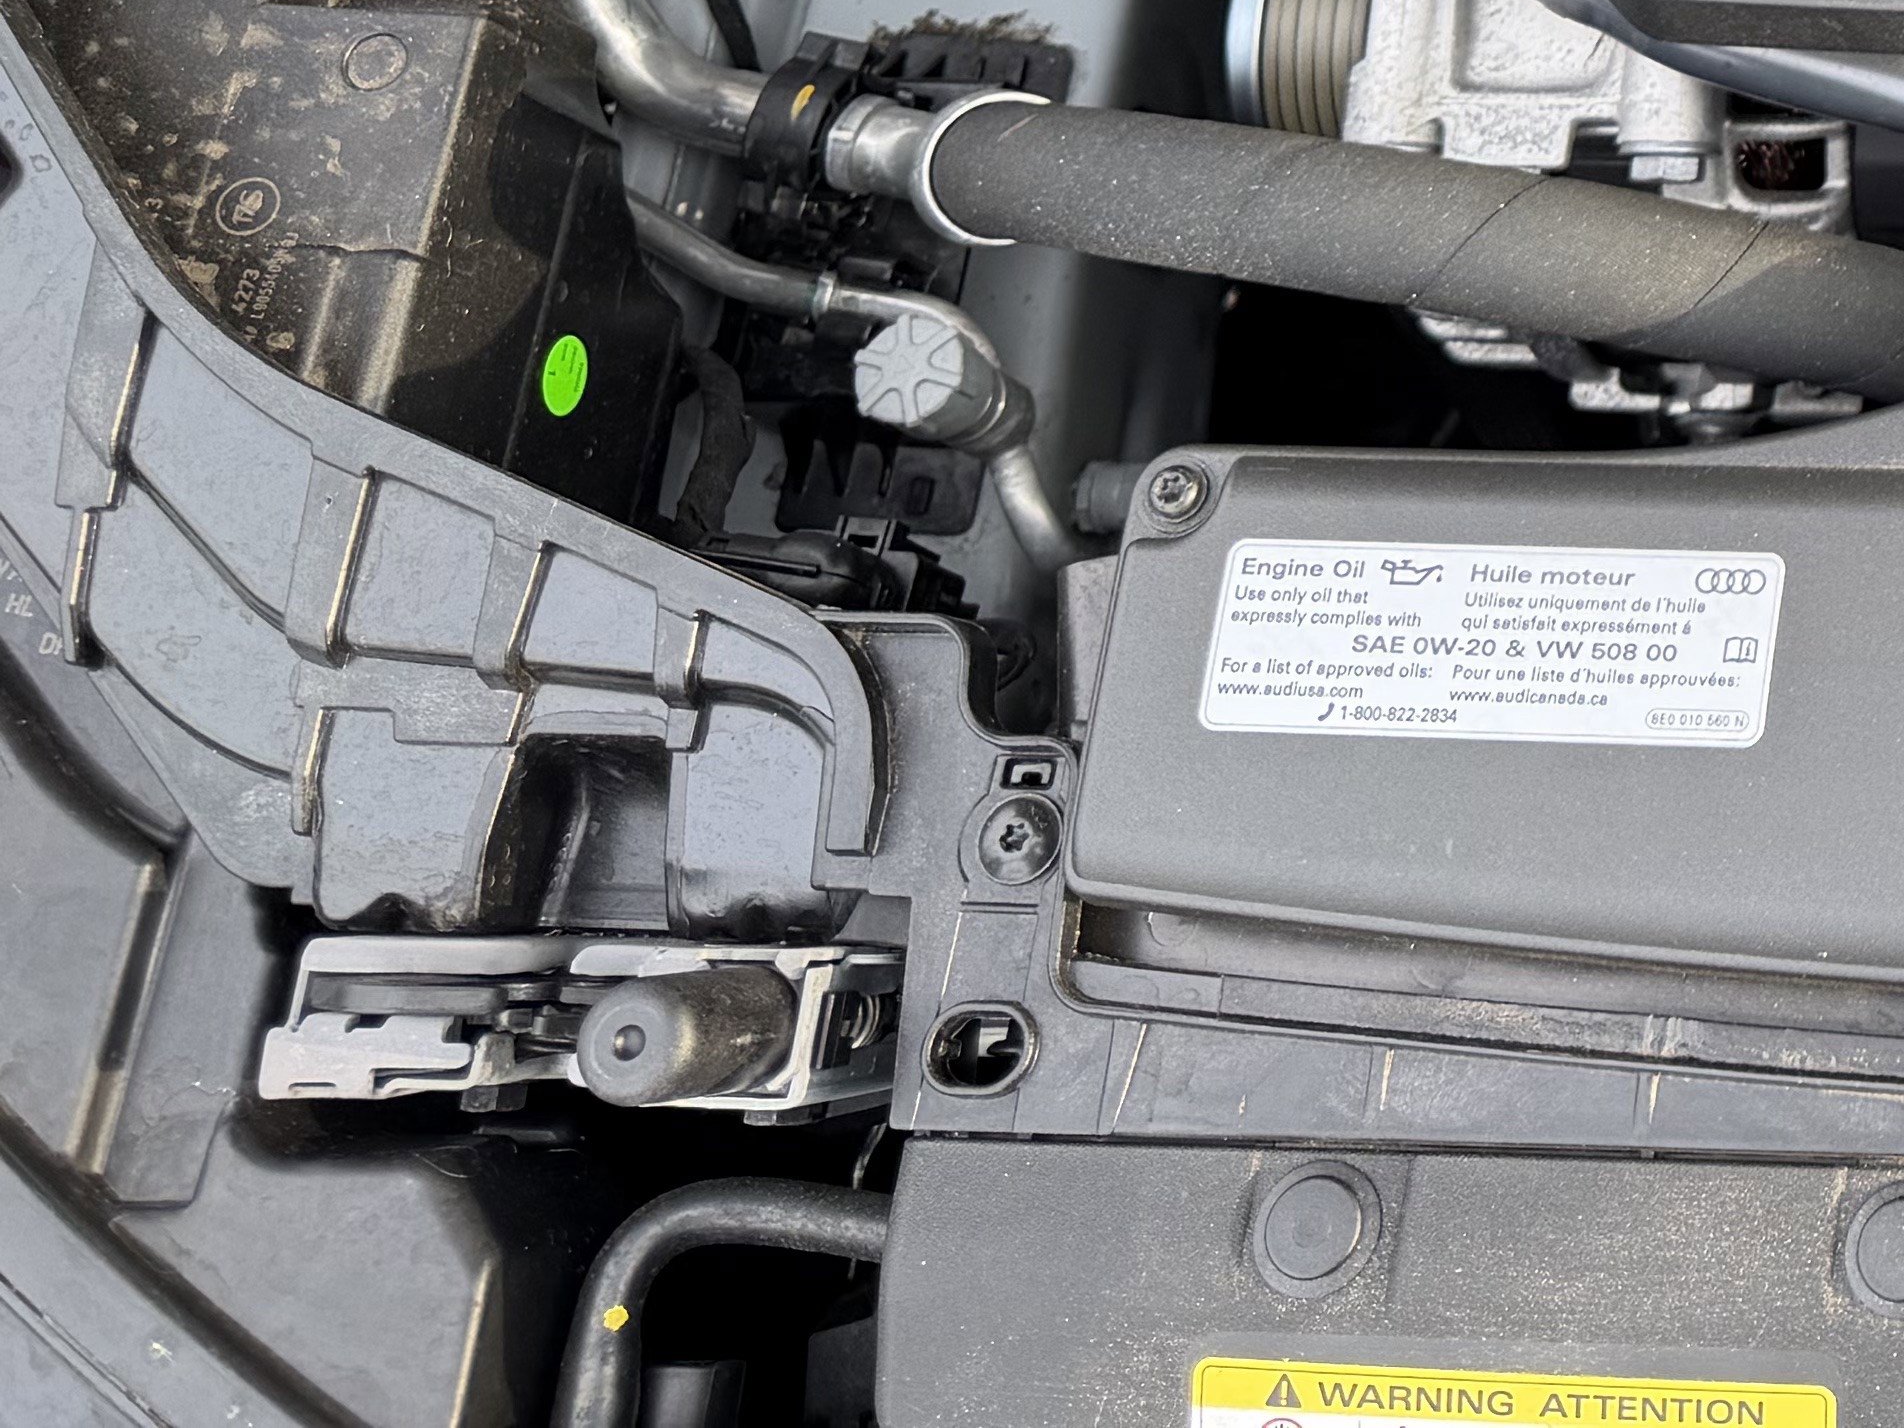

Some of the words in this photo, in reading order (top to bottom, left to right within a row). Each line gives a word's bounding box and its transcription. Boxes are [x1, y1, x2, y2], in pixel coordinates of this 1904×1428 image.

[1241, 557, 1323, 580] Engine
[1333, 560, 1365, 578] Oil
[1470, 564, 1532, 584] Huile
[1541, 569, 1636, 587] moteur
[1235, 585, 1266, 601] Use
[1271, 587, 1307, 605] only
[1311, 588, 1332, 603] oil
[1336, 588, 1368, 604] that
[1465, 592, 1523, 608] Utilisez
[1529, 593, 1626, 617] uniquement
[1631, 596, 1651, 613] de
[1656, 597, 1706, 614] l'huile
[1231, 609, 1306, 627] expressly
[1310, 611, 1382, 628] complies
[1387, 613, 1421, 628] with
[1461, 614, 1488, 632] qui
[1492, 615, 1557, 632] satisfait
[1561, 618, 1677, 635] expressément
[1351, 634, 1405, 654] SAE
[1413, 636, 1497, 657] 0W-20
[1505, 639, 1526, 658] &
[1537, 641, 1584, 659] VW
[1591, 642, 1638, 661] 508
[1646, 643, 1678, 662] 00
[1220, 657, 1248, 673] For
[1252, 661, 1262, 673] a
[1266, 659, 1291, 675] list
[1295, 659, 1314, 675] of
[1316, 661, 1394, 682] approved
[1400, 662, 1433, 679] oils:
[1452, 664, 1490, 681] Pour
[1496, 669, 1526, 682] une
[1531, 666, 1565, 683] liste
[1569, 667, 1634, 684] d'huiles
[1640, 670, 1741, 690] approuvées:
[1217, 681, 1363, 699] www.audiusa.com
[1449, 689, 1608, 707] www.audicanada.ca
[1341, 705, 1457, 723] 1-800-822-2834
[1679, 712, 1703, 727] 010
[1317, 1381, 1515, 1417] WARNING
[1540, 1393, 1766, 1426] ATTENTION
